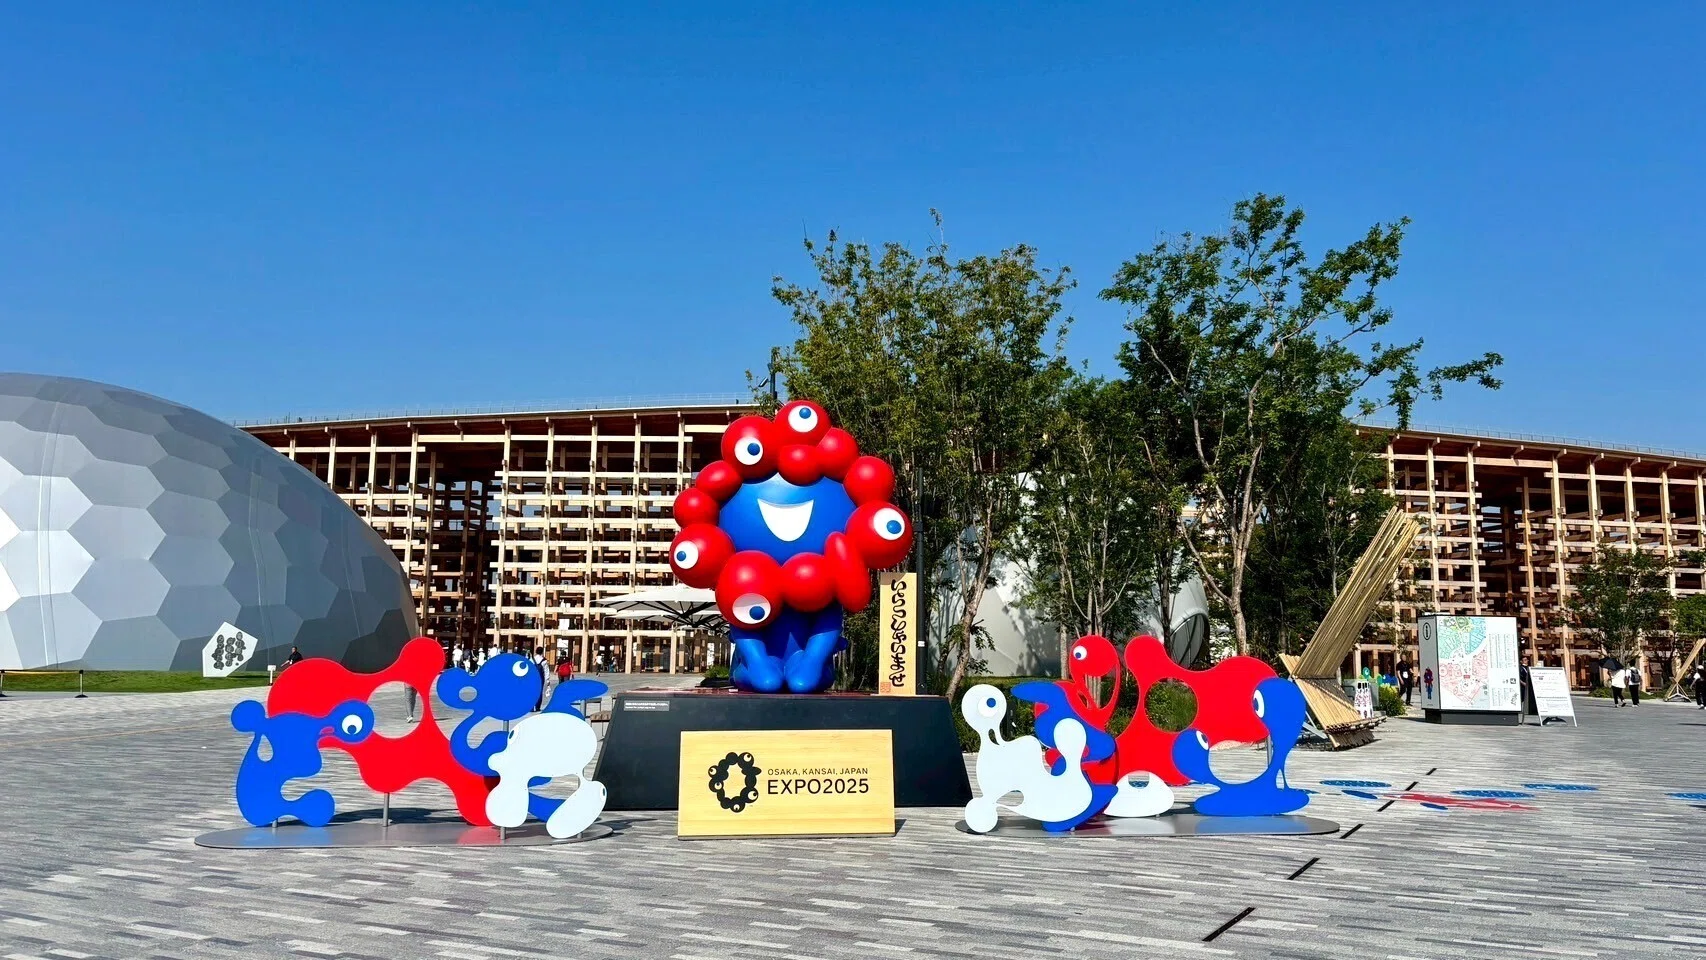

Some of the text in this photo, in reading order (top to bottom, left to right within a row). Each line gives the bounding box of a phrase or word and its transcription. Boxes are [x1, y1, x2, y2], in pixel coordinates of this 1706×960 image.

[767, 768, 801, 776] OSAKA,
[839, 767, 868, 775] JAPAN
[767, 778, 869, 795] EXPO2025
